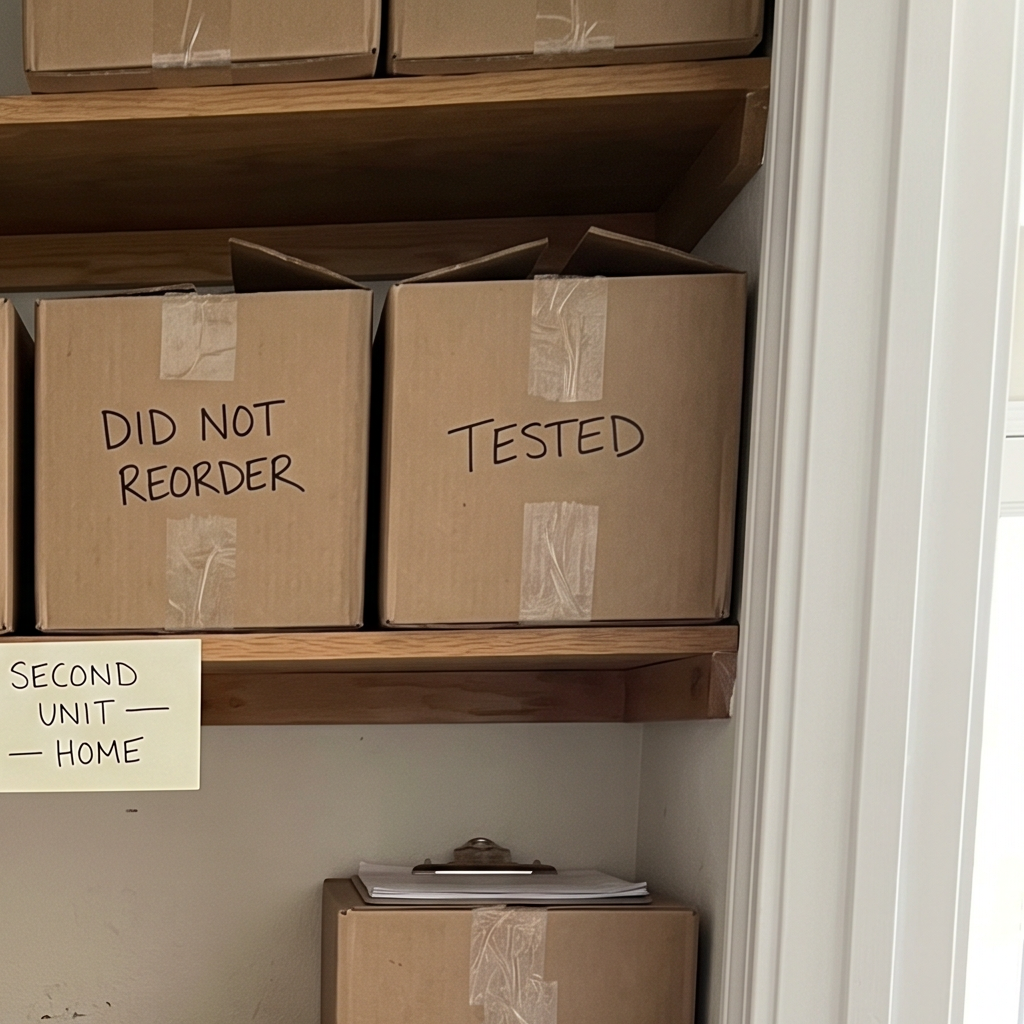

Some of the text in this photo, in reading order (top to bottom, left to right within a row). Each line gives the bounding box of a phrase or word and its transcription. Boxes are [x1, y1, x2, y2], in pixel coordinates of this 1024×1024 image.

[102, 400, 285, 450] DID NOT
[448, 415, 644, 472] TESTED
[119, 455, 305, 505] REORDER
[10, 661, 138, 690] SECOND
[39, 699, 115, 727] UNIT
[56, 736, 144, 768] HOME
